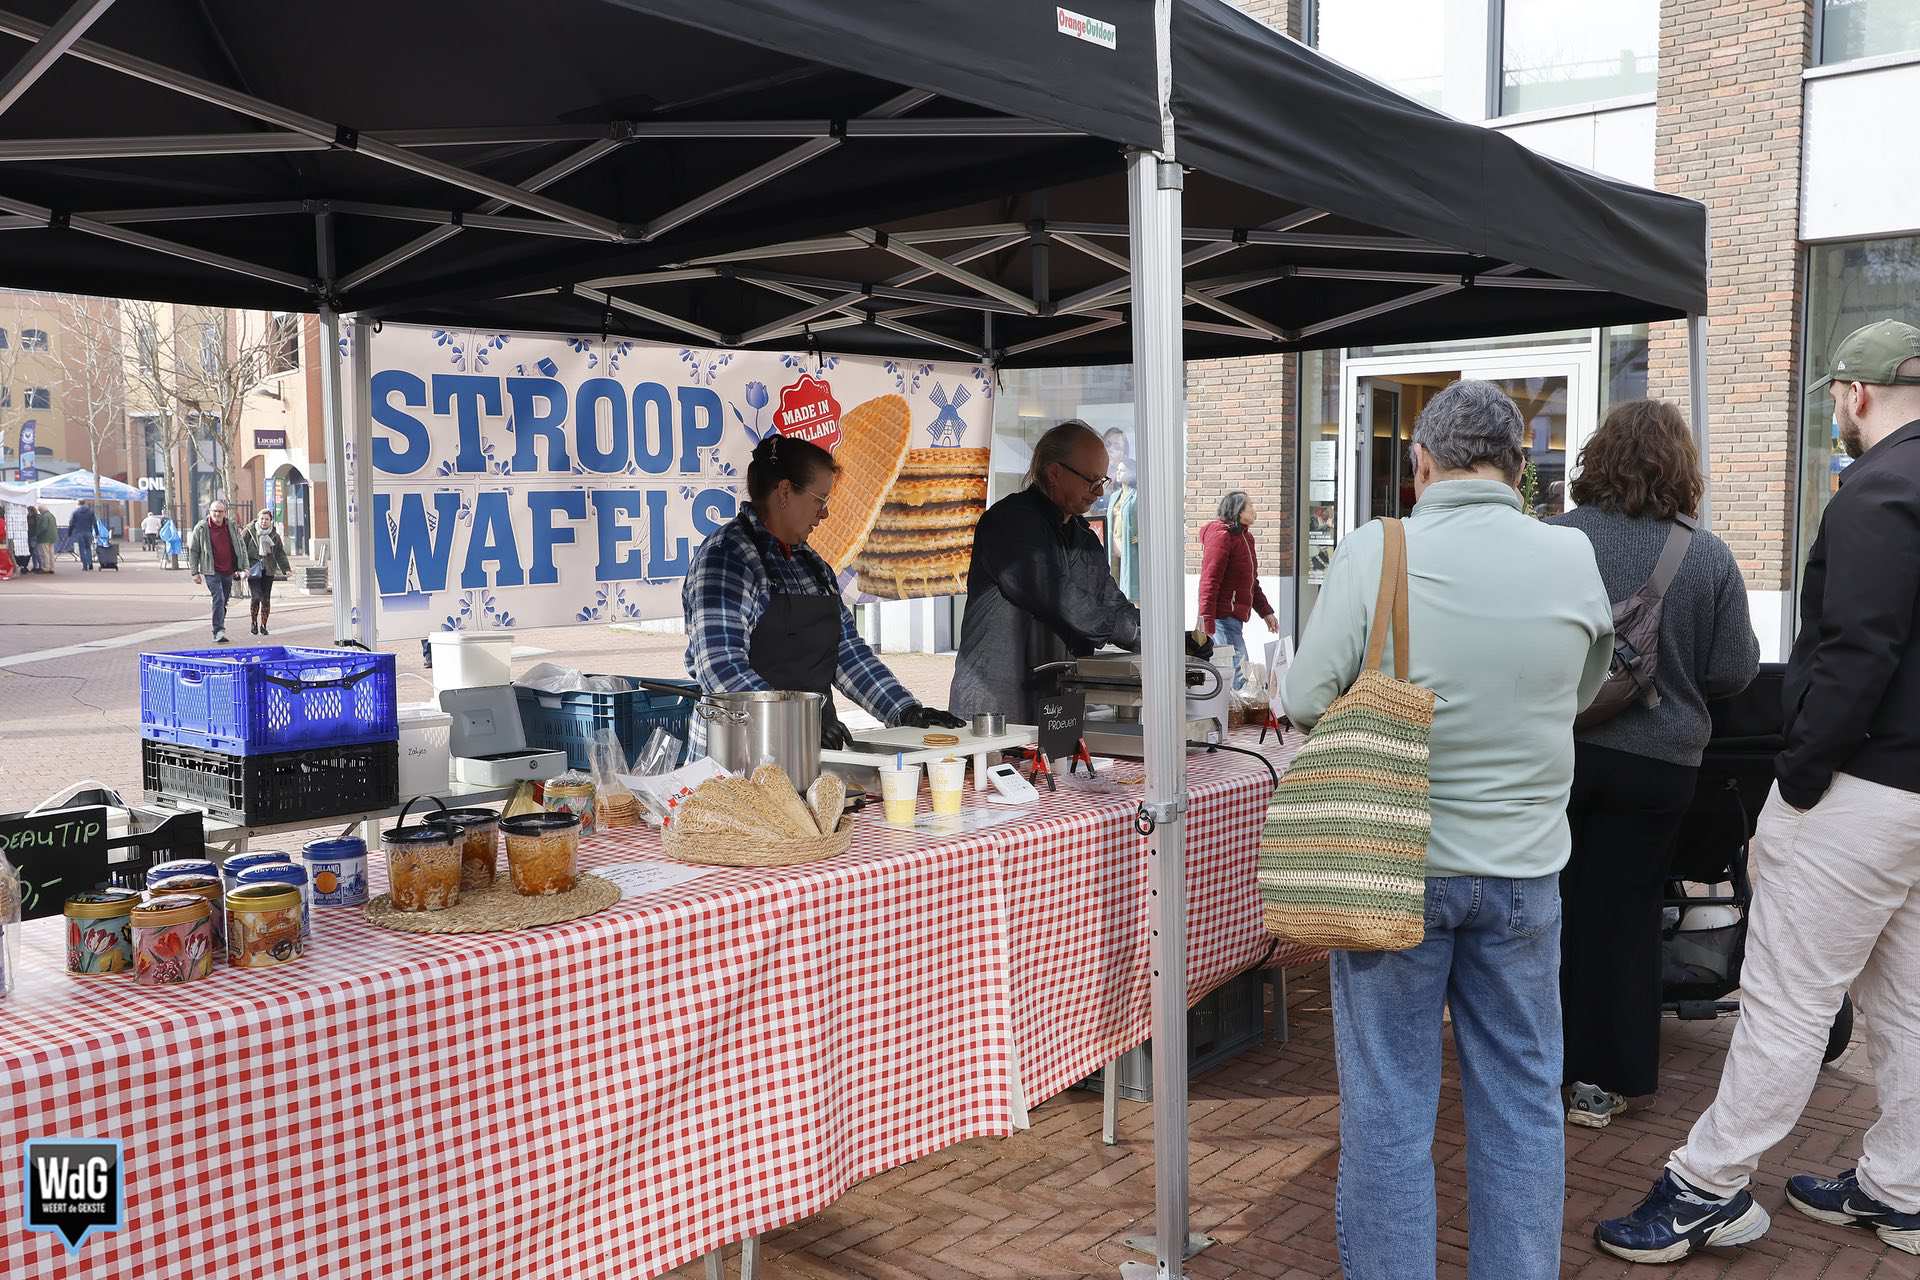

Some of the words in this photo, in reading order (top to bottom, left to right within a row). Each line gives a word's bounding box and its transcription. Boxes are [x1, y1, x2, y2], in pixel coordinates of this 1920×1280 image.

[371, 369, 724, 474] STROOP
[782, 404, 817, 426] MADE
[817, 399, 830, 415] IN
[138, 476, 168, 491] ONL
